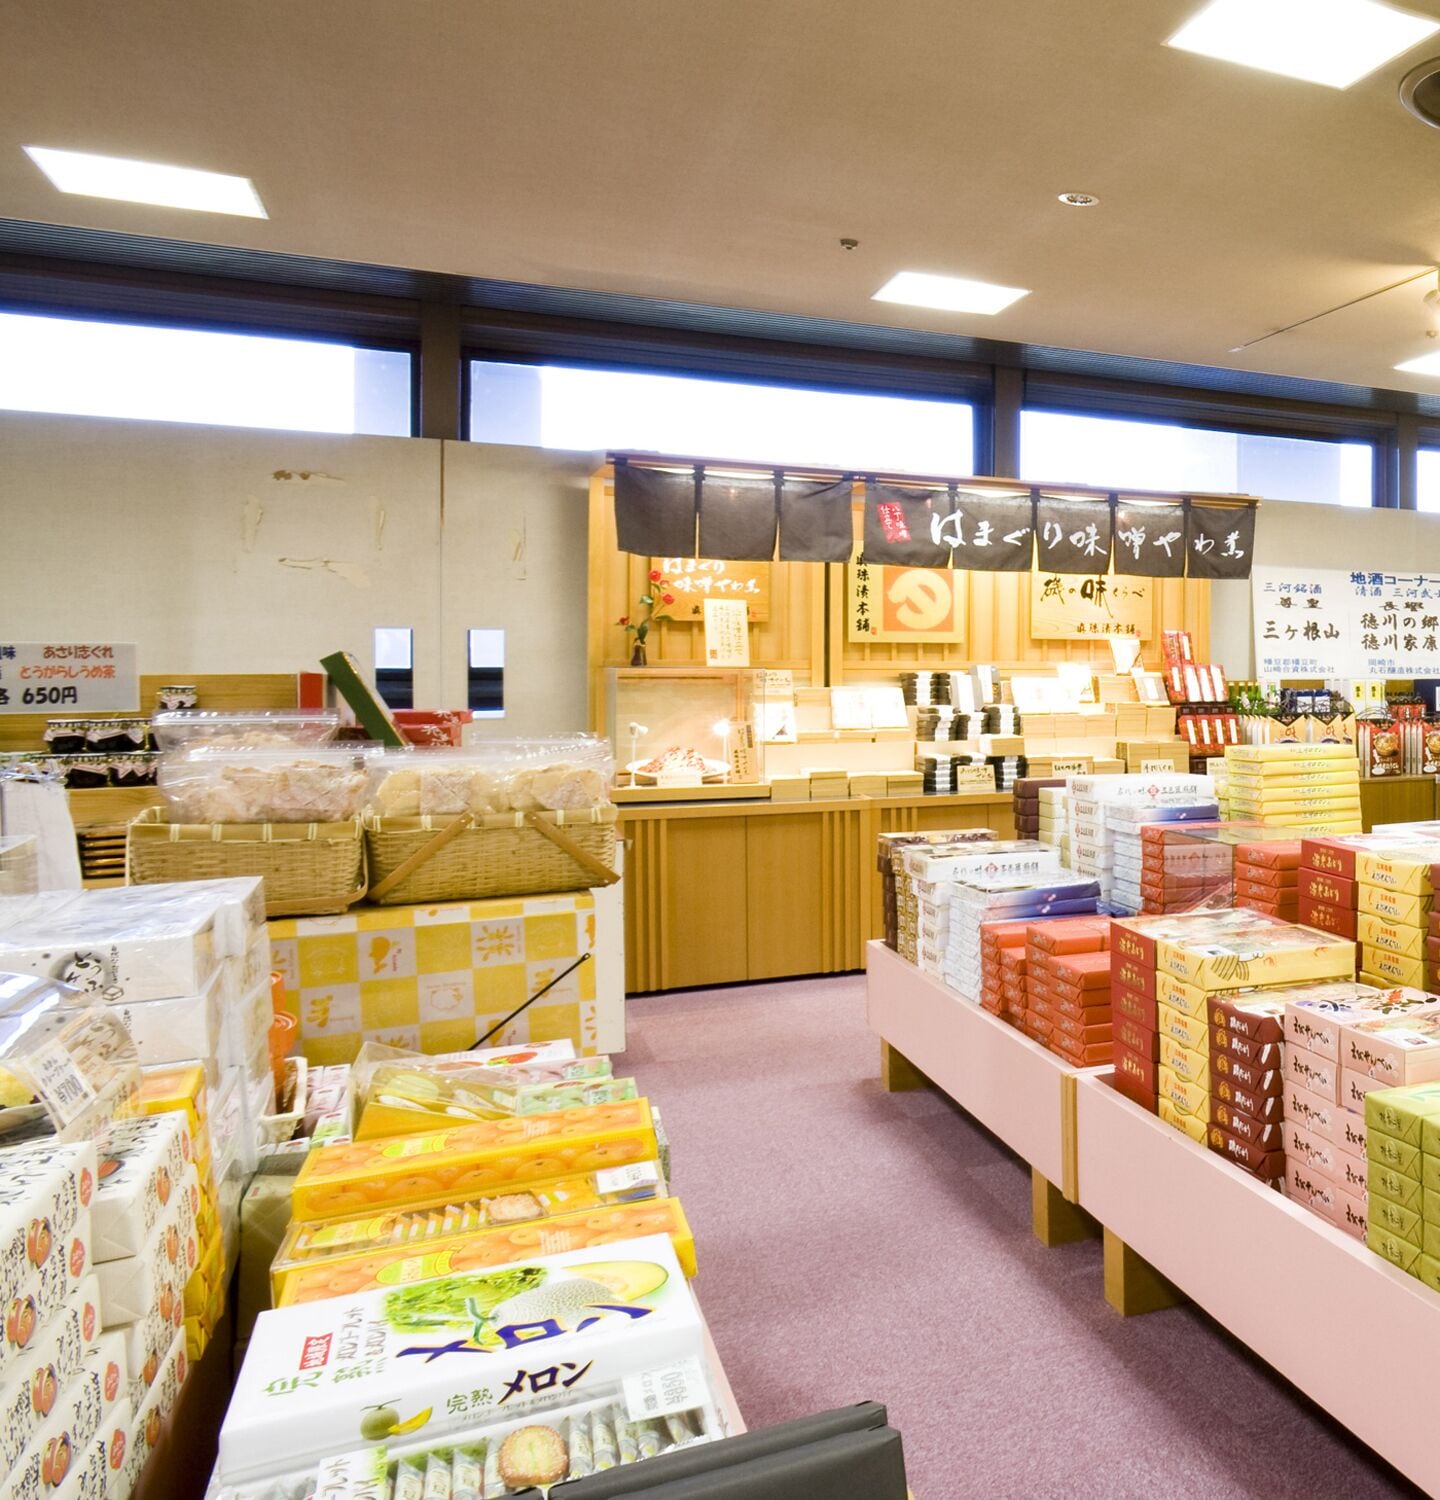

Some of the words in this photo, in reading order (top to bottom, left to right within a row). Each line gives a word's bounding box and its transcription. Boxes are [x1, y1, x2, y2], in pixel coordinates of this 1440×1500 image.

[1264, 583, 1322, 595] 三河銘酒
[1355, 587, 1382, 598] 清酒
[1360, 614, 1439, 631] 徳川の郷
[1361, 633, 1439, 651] 徳川家康
[1368, 658, 1395, 666] 岡崎市
[22, 686, 78, 705] 650円
[396, 1304, 653, 1363] メロン
[447, 1388, 493, 1414] 完熟
[498, 1360, 593, 1404] メロン
